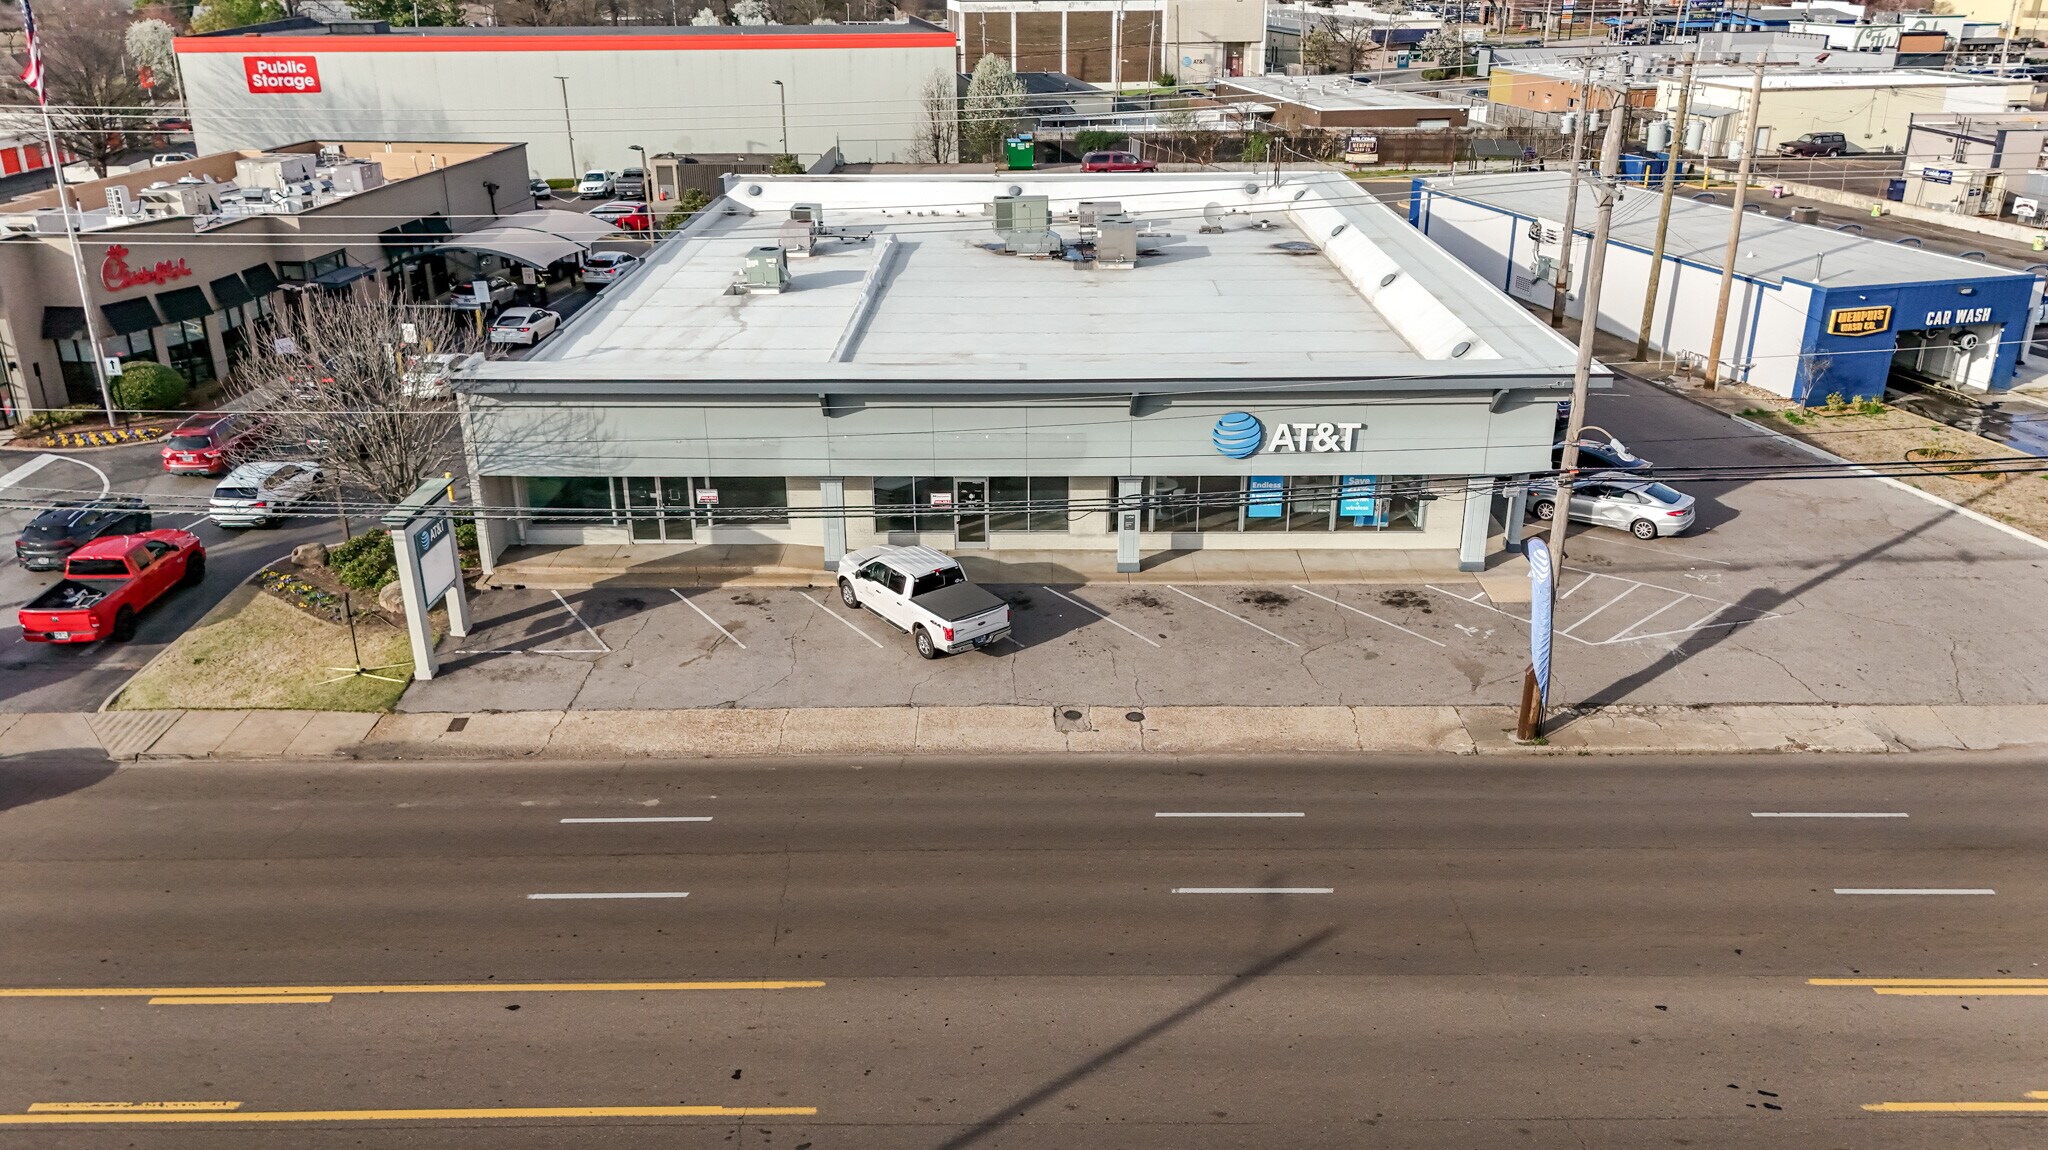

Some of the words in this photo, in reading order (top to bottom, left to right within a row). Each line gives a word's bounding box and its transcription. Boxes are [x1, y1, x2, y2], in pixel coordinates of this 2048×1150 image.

[257, 60, 307, 73] Public
[252, 74, 315, 90] Storage
[1837, 309, 1885, 324] MEMPHIS
[1925, 310, 1952, 326] CAR
[1955, 307, 1992, 324] WASH
[1840, 322, 1864, 333] WASH
[1268, 422, 1362, 452] AT&T
[1252, 481, 1281, 489] Endless
[1348, 476, 1371, 486] Save
[430, 519, 444, 542] AT&T
